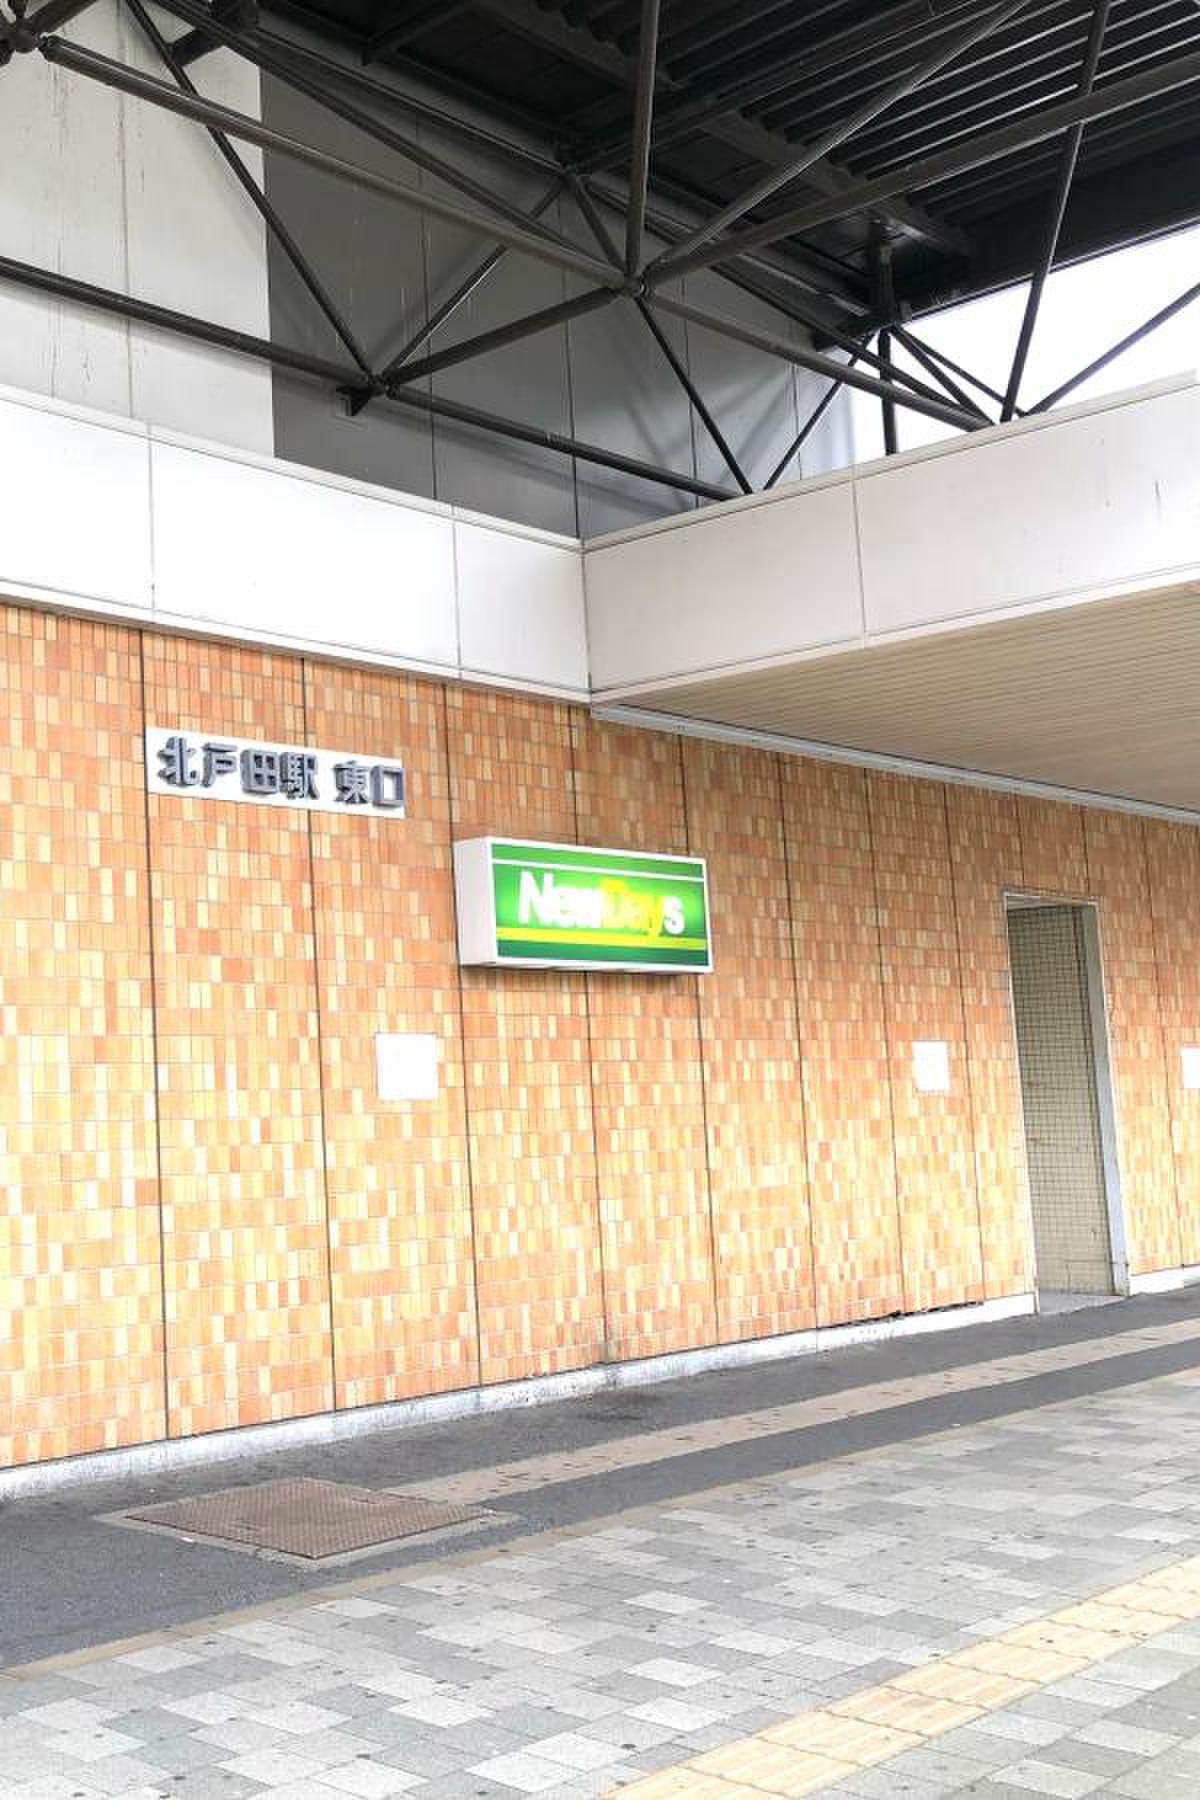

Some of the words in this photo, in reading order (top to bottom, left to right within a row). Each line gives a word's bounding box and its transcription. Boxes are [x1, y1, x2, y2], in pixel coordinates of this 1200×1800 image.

[157, 736, 320, 799] 北戸田駅
[333, 760, 404, 808] 東口
